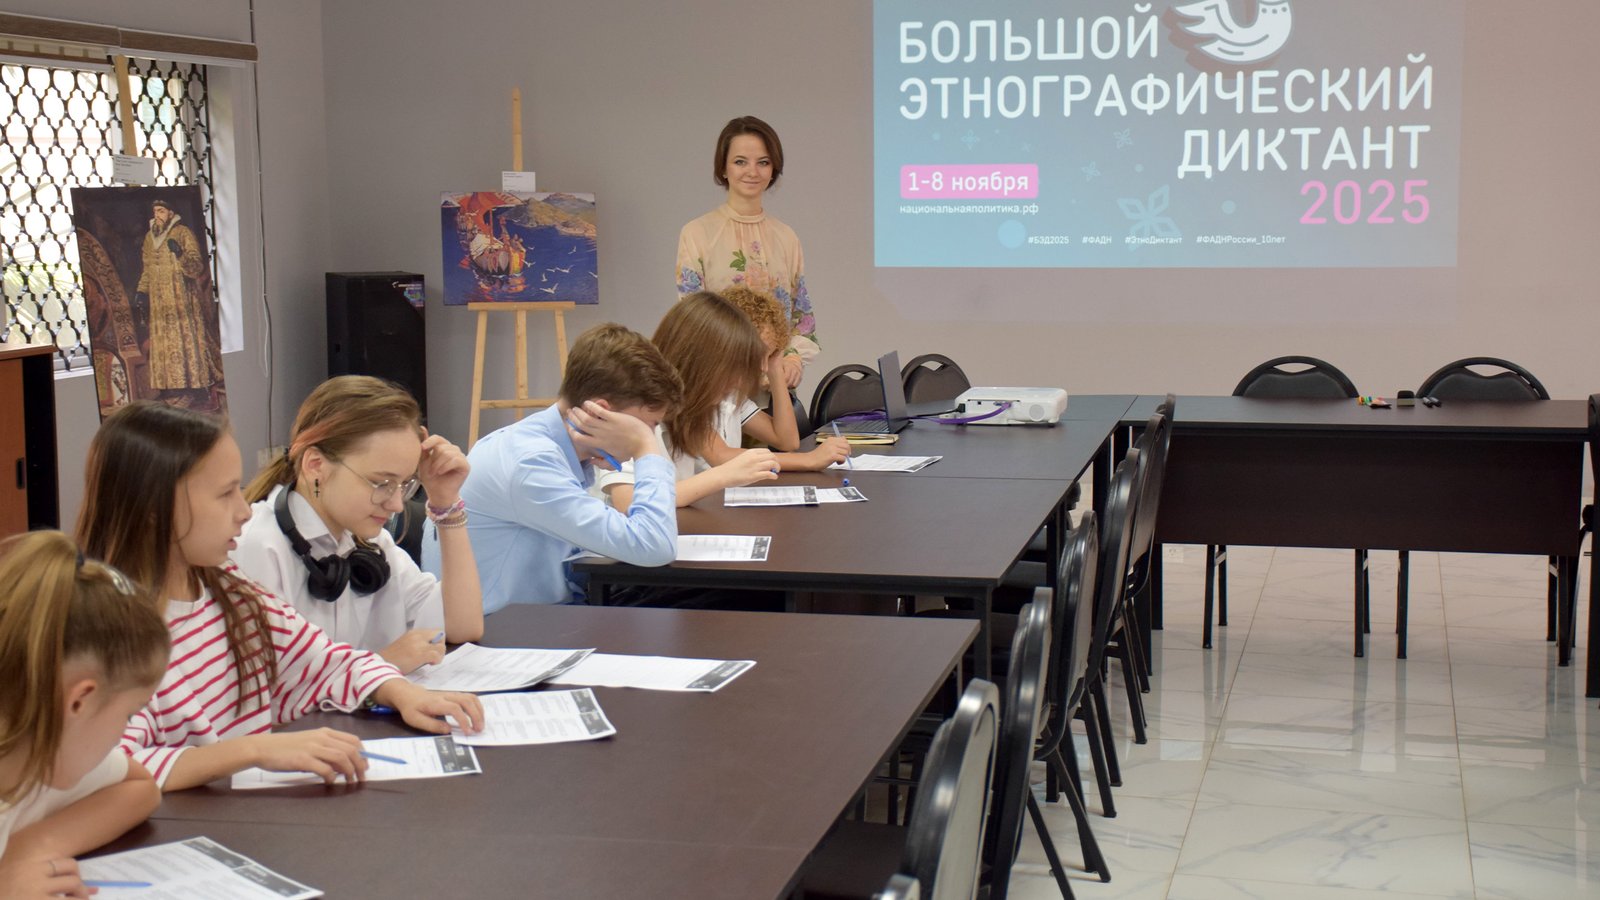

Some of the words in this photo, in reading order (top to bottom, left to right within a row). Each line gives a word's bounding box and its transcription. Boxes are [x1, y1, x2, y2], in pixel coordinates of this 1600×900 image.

[900, 3, 1158, 64] БОЛЬШОЙ
[899, 52, 1433, 120] ЭТНОГРАФИЧЕСКИЙ
[1177, 125, 1431, 180] ДИКТАНТ
[908, 171, 944, 192] 1-8
[951, 171, 1029, 196] ноября
[1299, 179, 1430, 225] 2025
[899, 203, 1039, 215] национальнаяполитика.рф
[1081, 235, 1112, 245] #ФАДН
[1124, 235, 1183, 245] #ЭтноДиктант
[1196, 235, 1286, 246] #ФАДНРоссии_10лет
